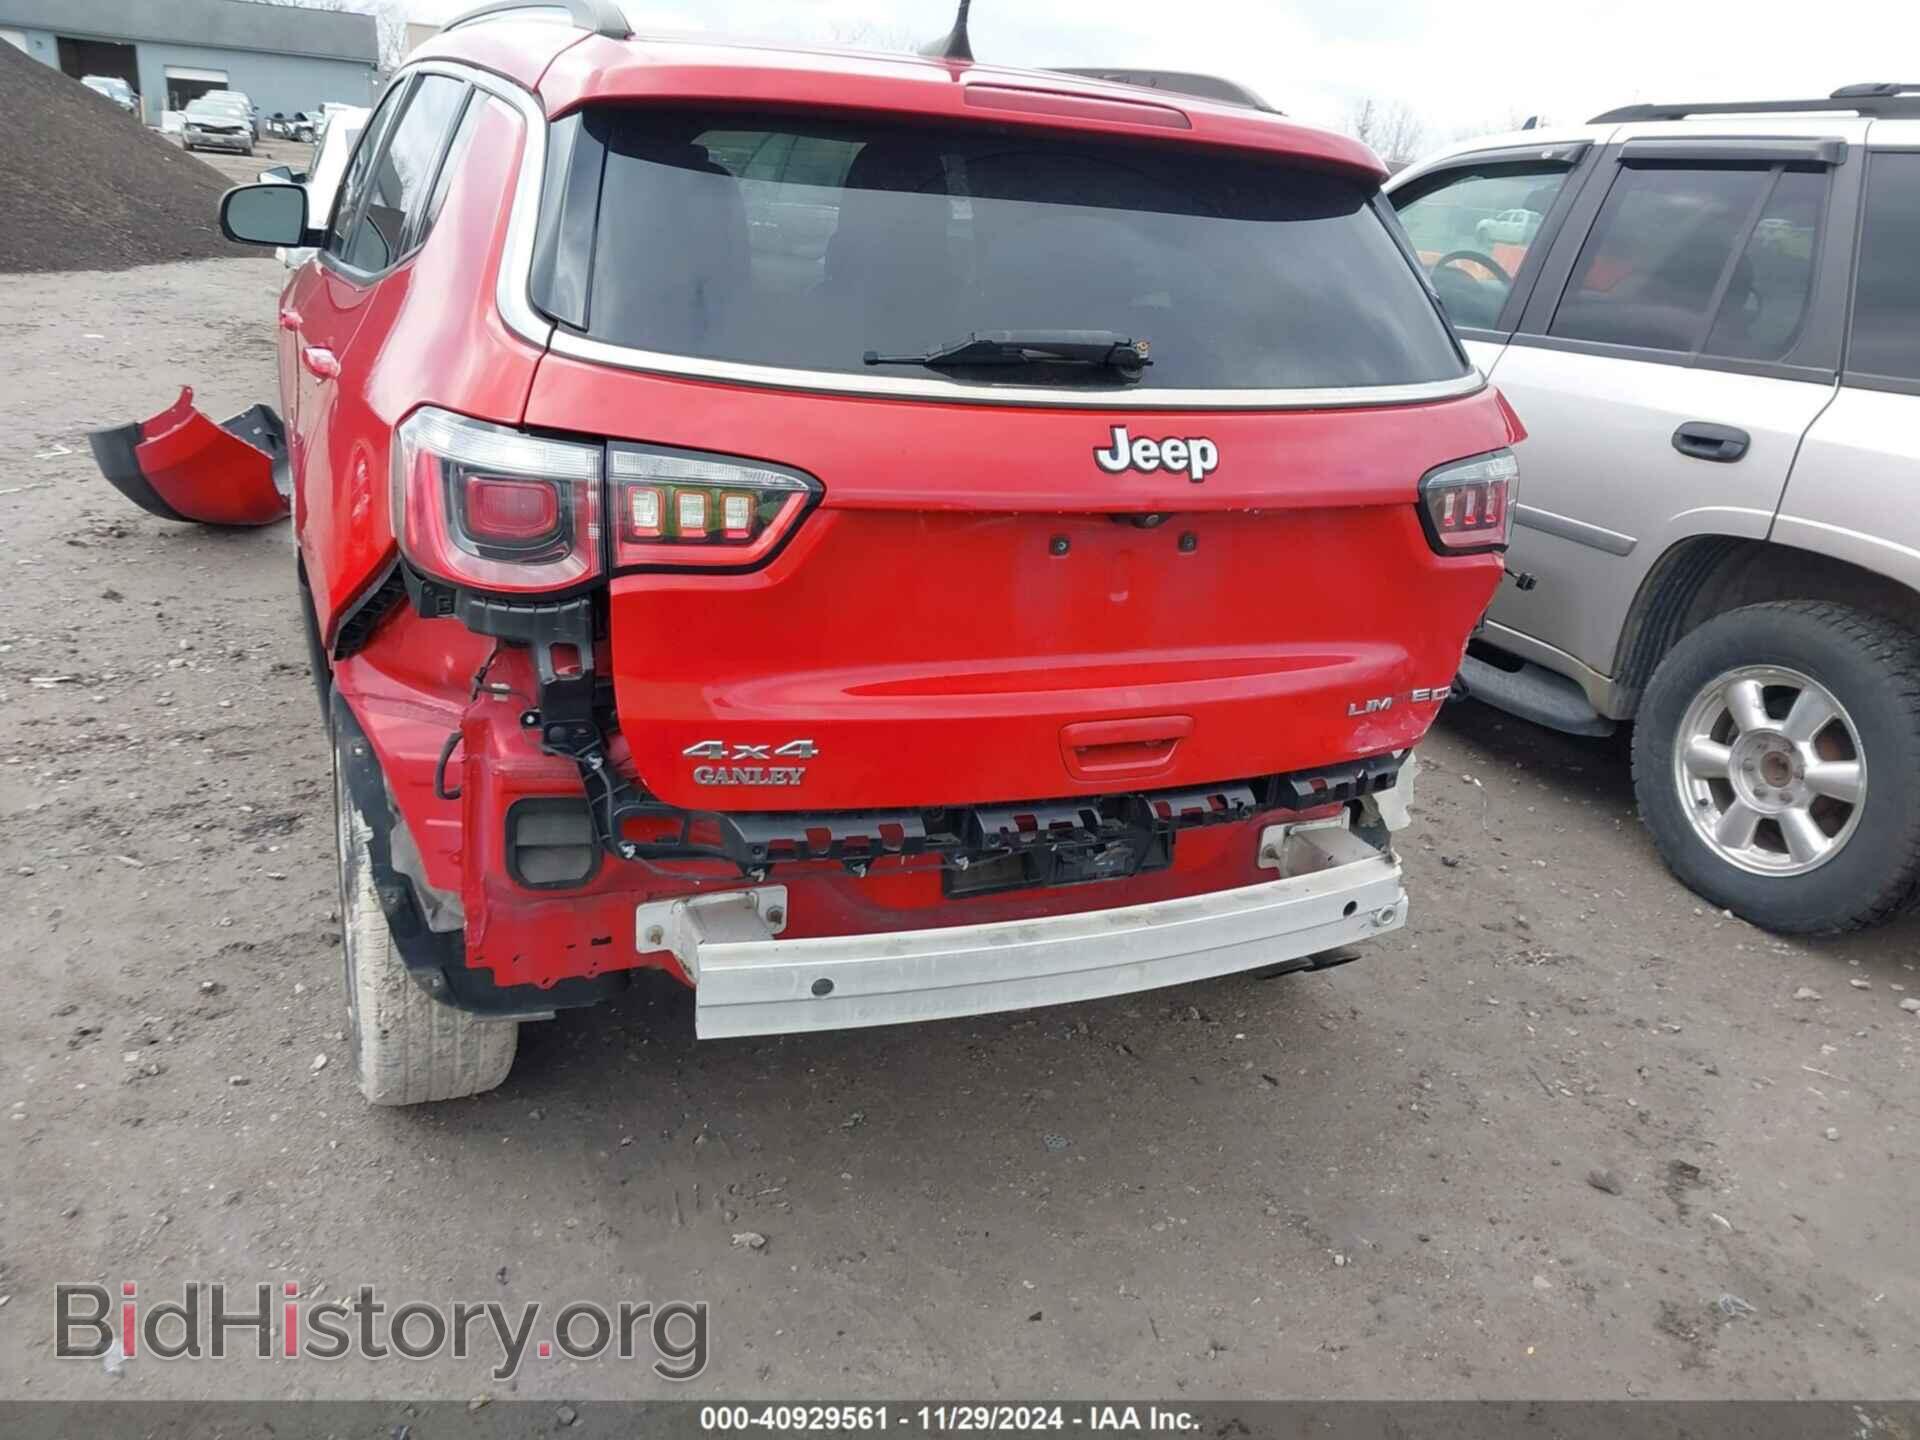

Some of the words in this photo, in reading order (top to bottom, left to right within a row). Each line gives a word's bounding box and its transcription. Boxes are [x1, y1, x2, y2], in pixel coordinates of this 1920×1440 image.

[1094, 425, 1219, 482] Jeep
[1347, 685, 1452, 716] LIMED
[682, 740, 819, 760] 4x4
[693, 766, 805, 785] GANLEY
